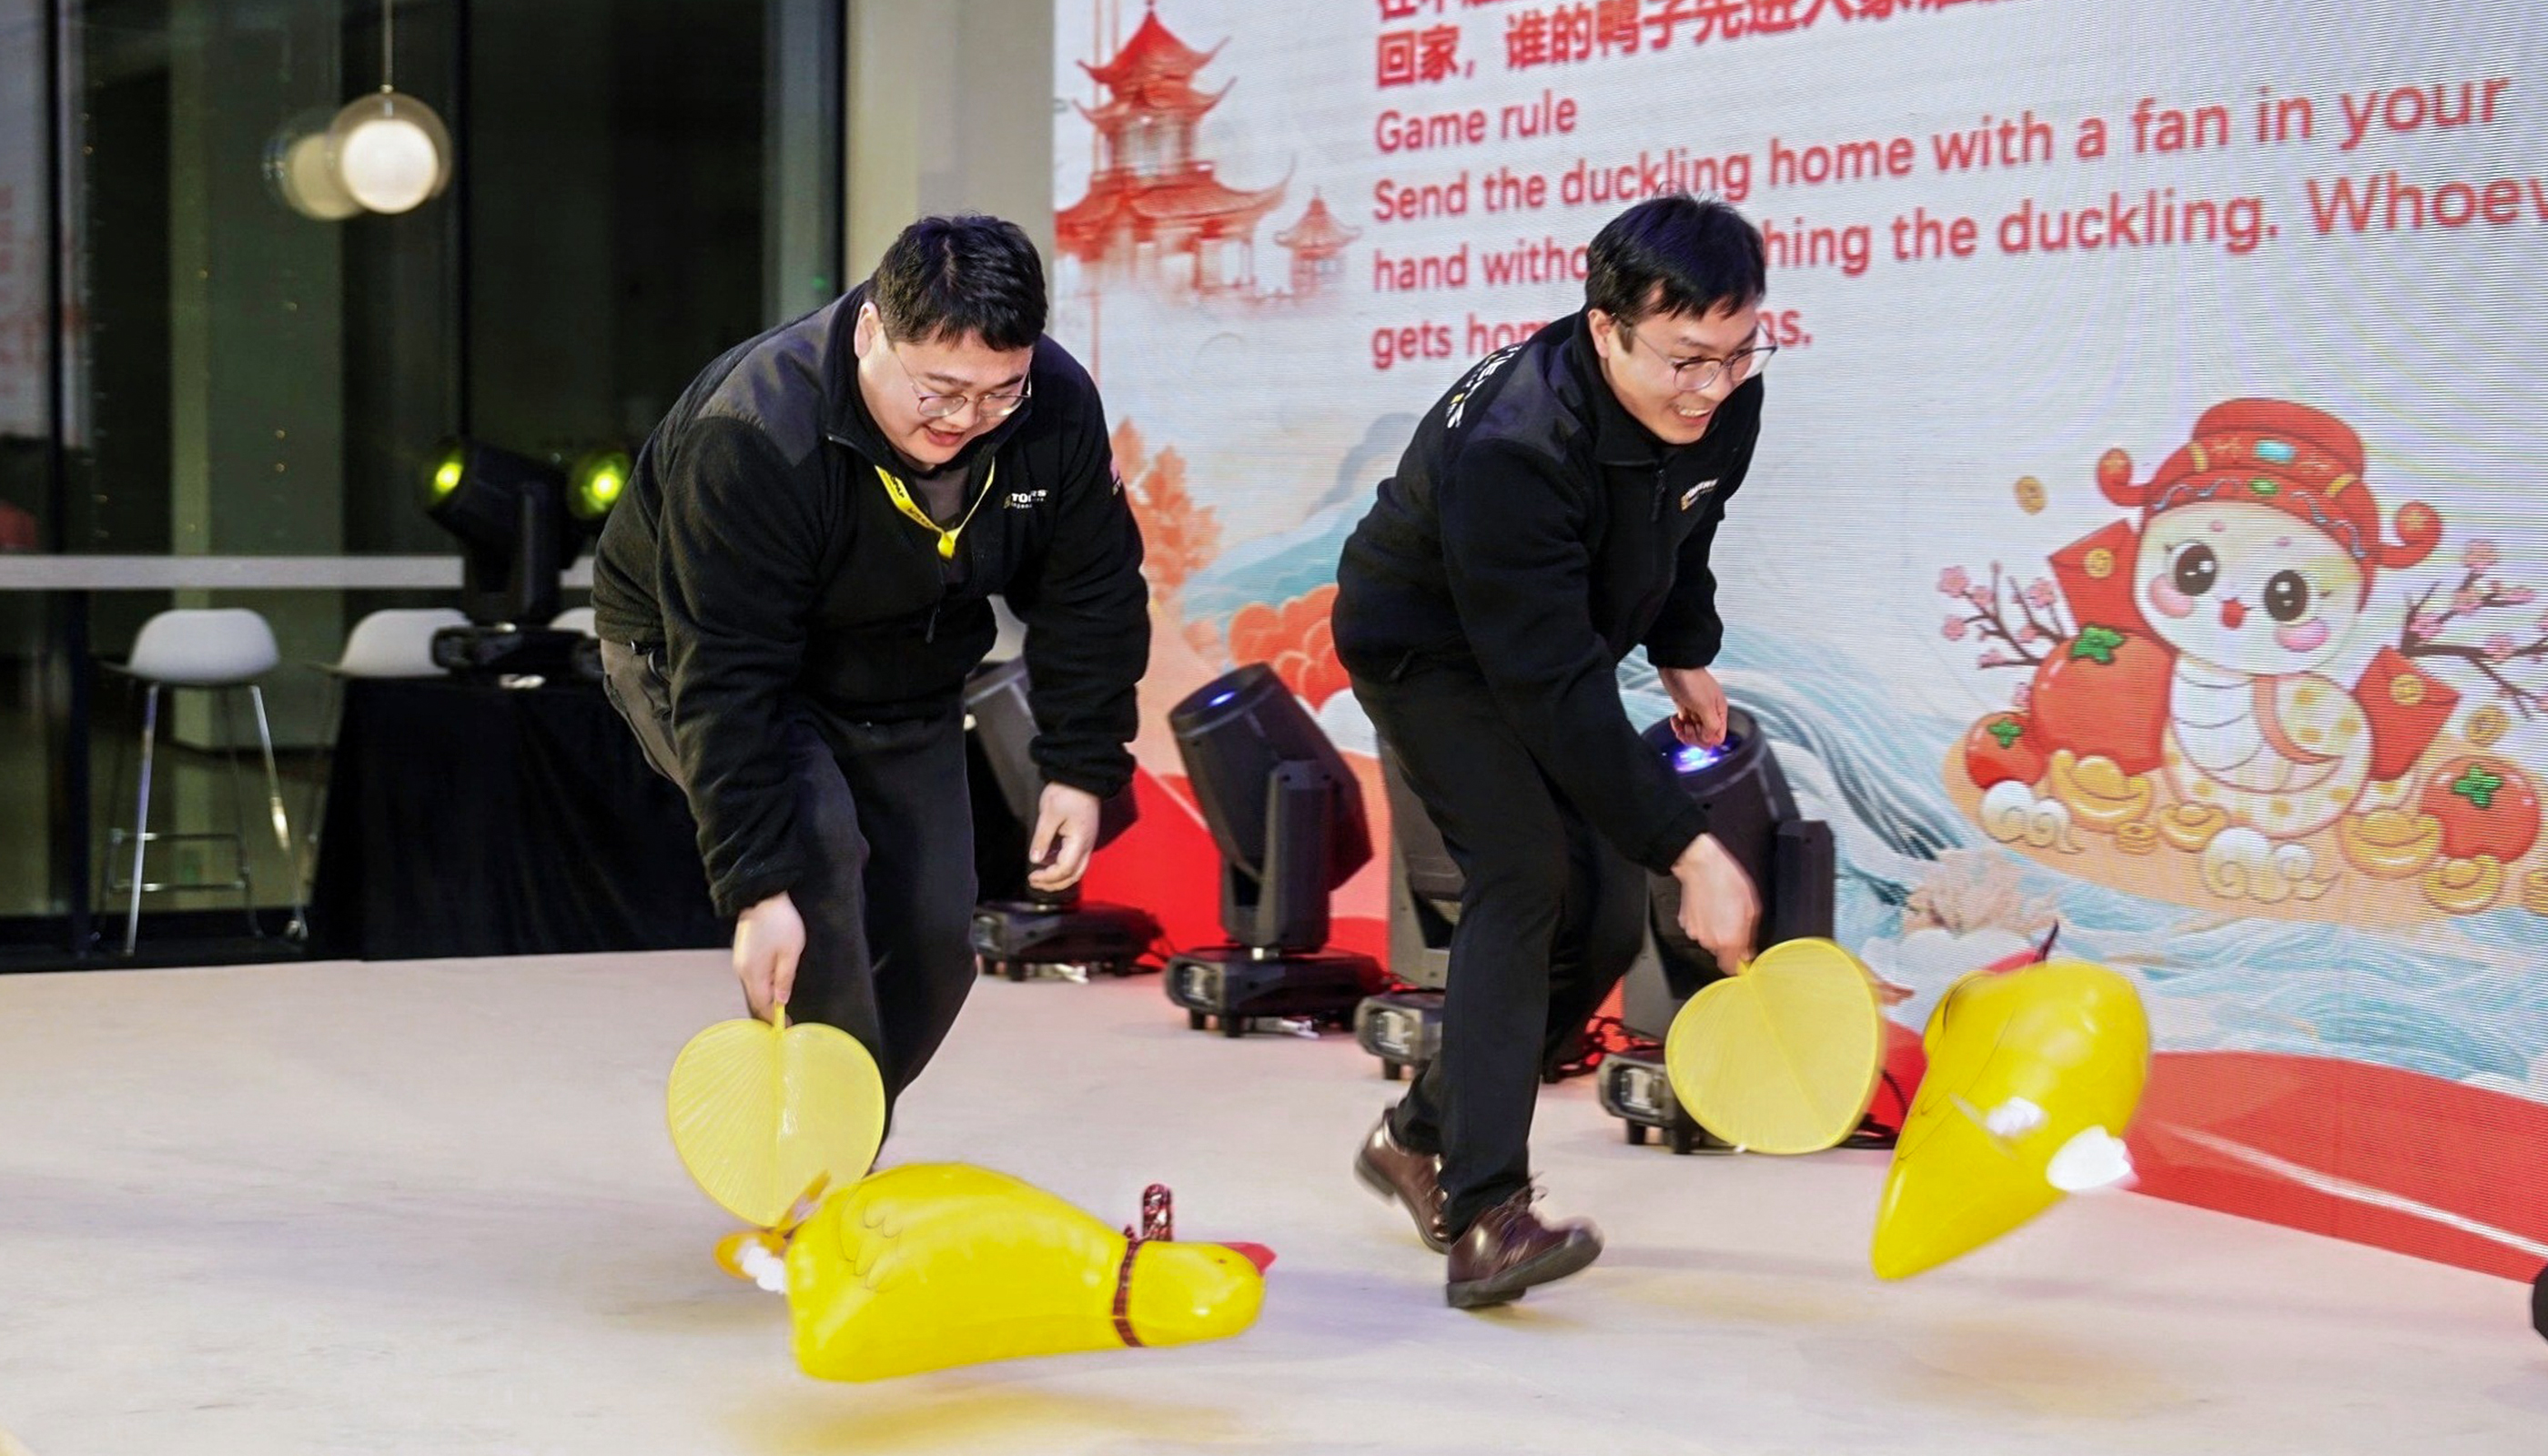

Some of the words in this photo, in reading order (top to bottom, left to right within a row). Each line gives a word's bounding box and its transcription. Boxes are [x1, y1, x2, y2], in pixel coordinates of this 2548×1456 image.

[1374, 171, 1470, 222] Send
[1483, 167, 1547, 213] the
[1562, 147, 1753, 203] duckling
[1771, 136, 1915, 185] home
[1934, 112, 2053, 172] with
[2077, 116, 2107, 159] a
[2133, 97, 2230, 154] fan
[2258, 86, 2314, 142] in
[2340, 77, 2510, 150] your
[1376, 109, 1487, 154] Game
[1502, 91, 1578, 138] rule
[1375, 243, 1470, 291] hand
[1482, 238, 1590, 286] witho
[1763, 217, 1872, 277] hing
[1892, 207, 1978, 260] the
[1999, 188, 2279, 256] duckling.
[1373, 320, 1452, 370] gets
